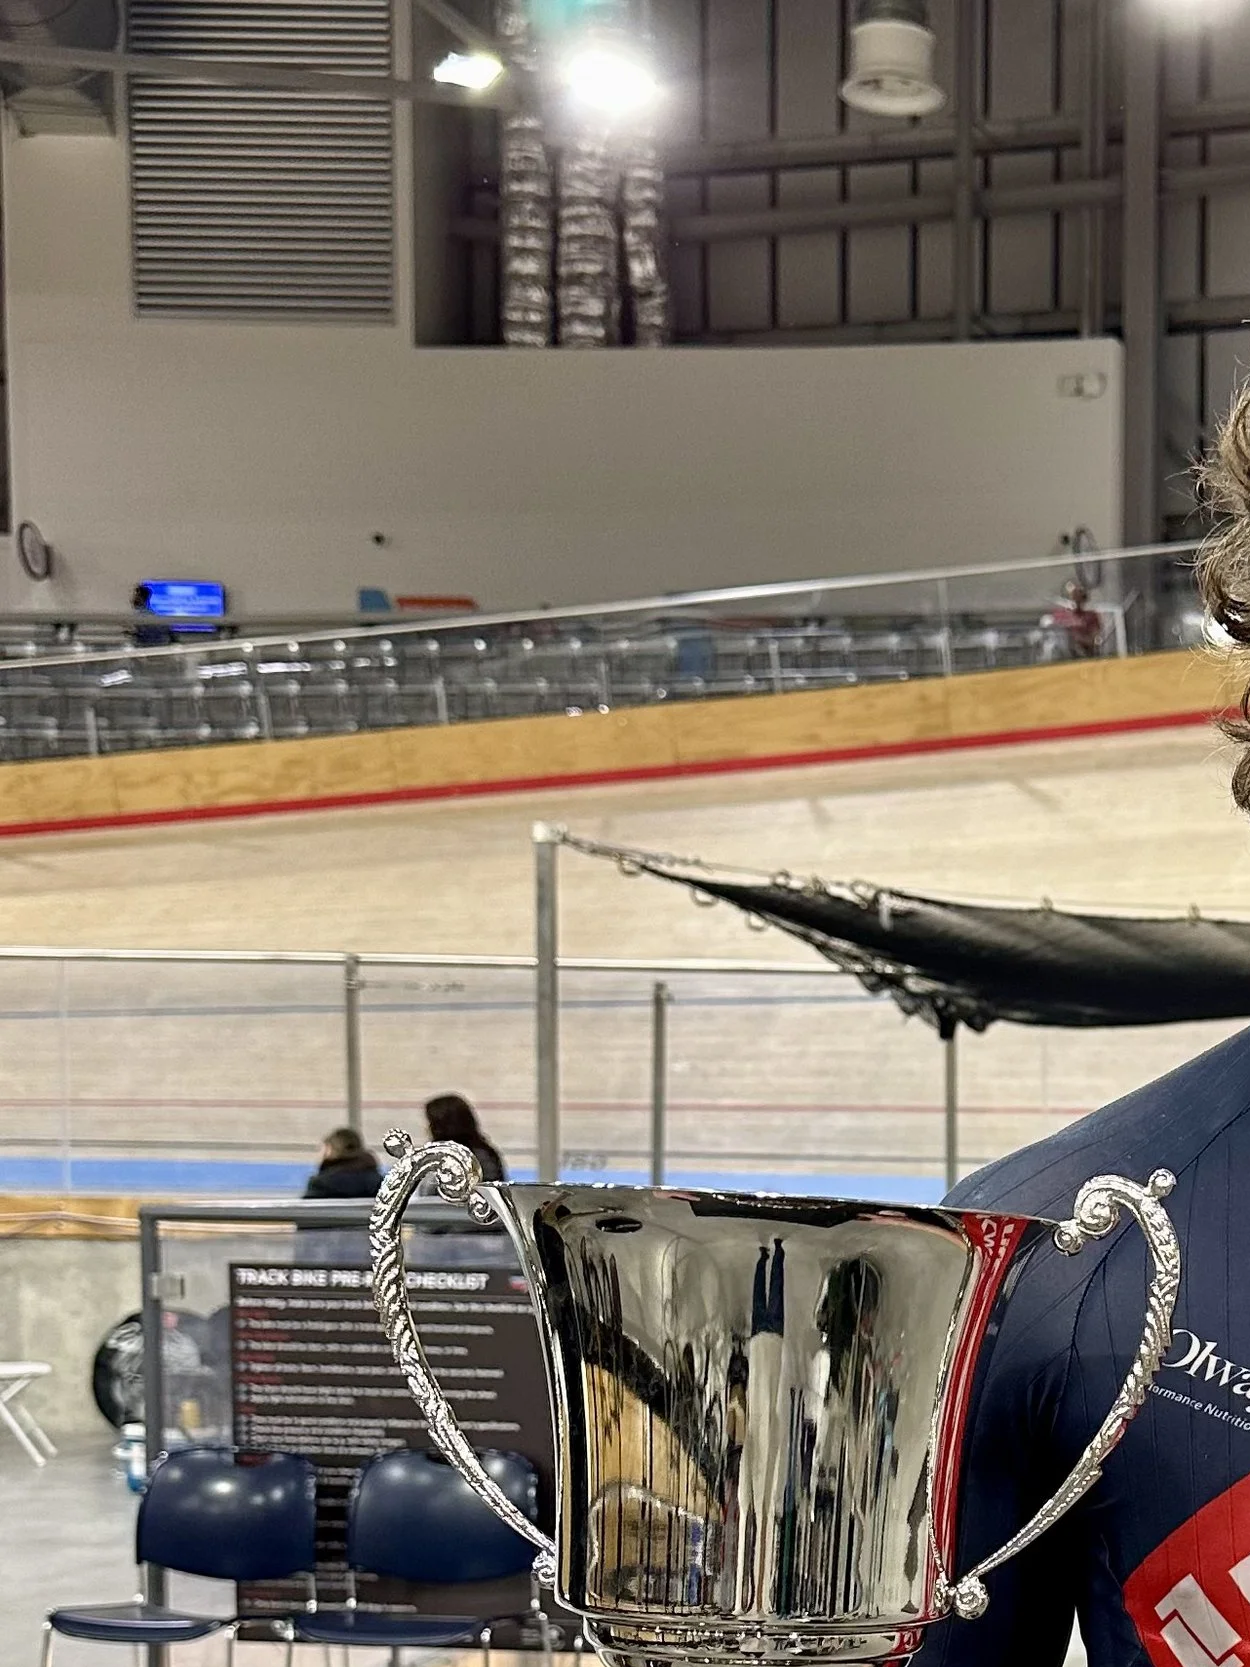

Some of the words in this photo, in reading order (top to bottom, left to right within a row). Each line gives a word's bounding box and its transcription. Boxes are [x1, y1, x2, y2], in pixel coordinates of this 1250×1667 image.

[237, 1268, 289, 1286] TRACK
[291, 1269, 327, 1287] BIKE
[405, 1272, 489, 1291] CHECKLIST
